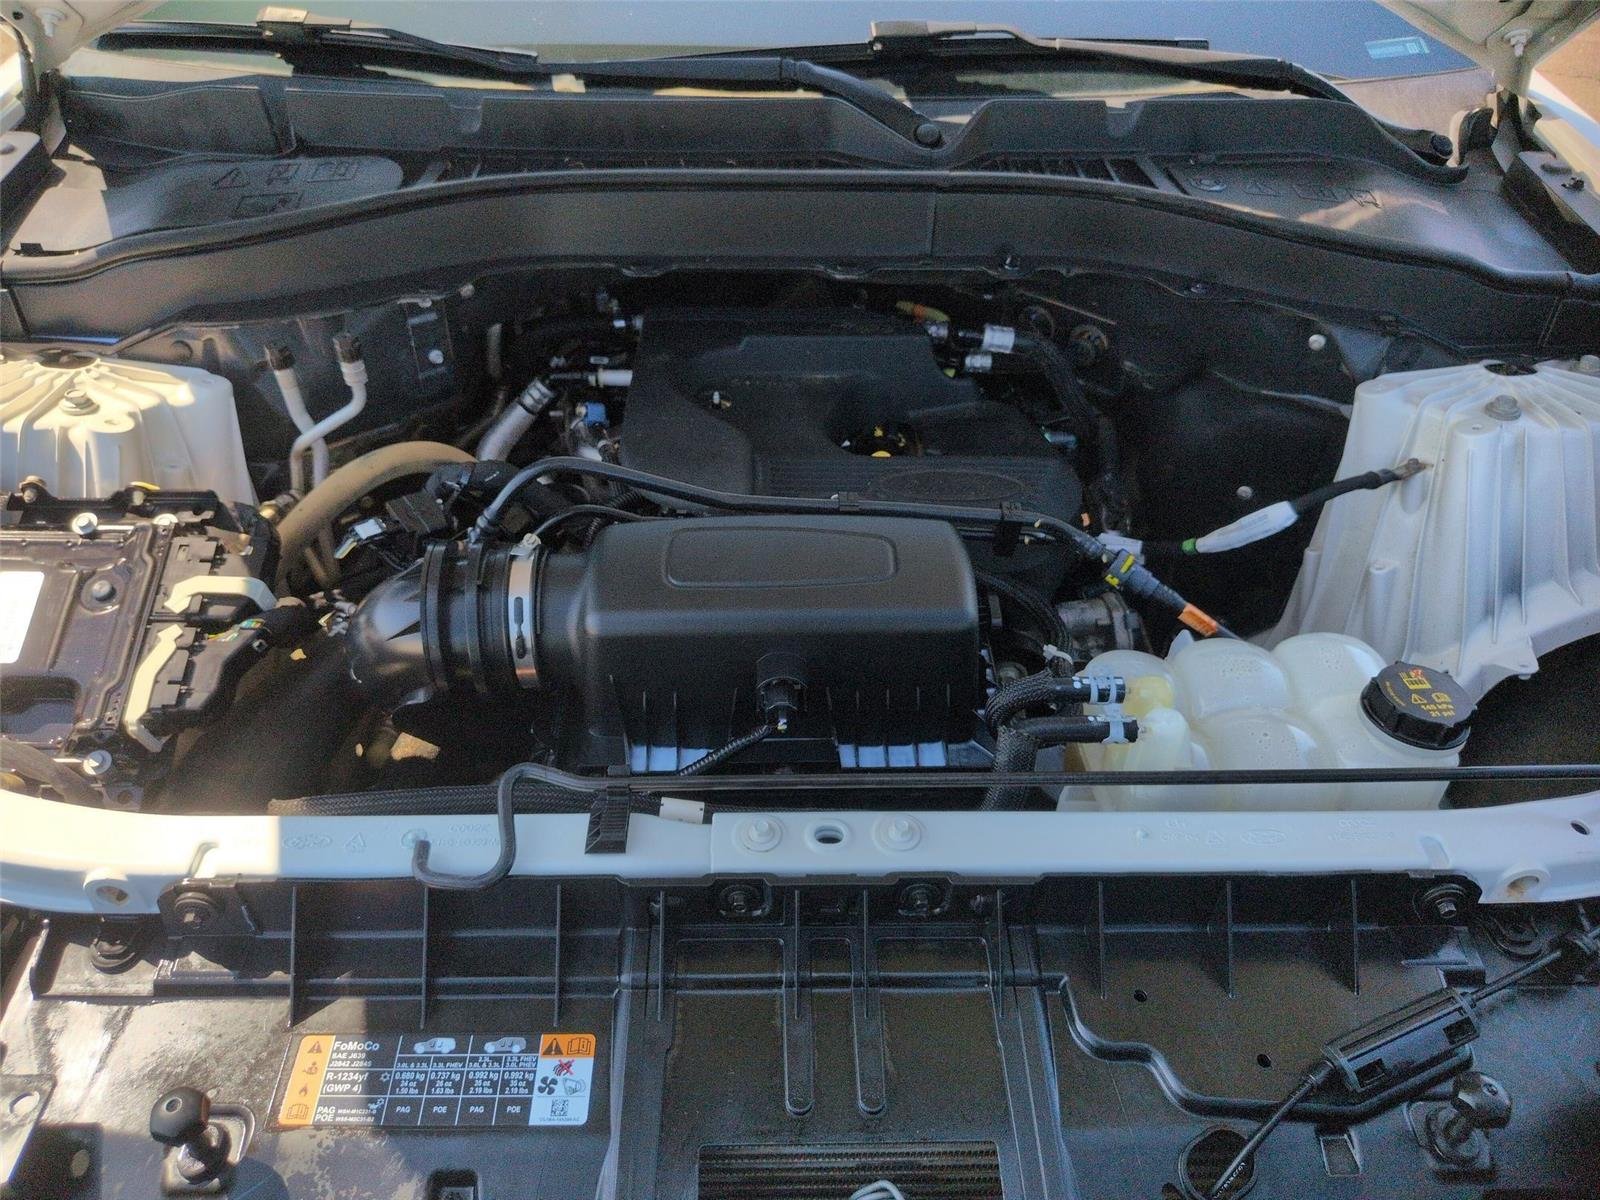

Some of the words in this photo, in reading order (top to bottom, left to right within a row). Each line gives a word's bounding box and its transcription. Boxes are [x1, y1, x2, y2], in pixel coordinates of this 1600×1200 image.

[333, 1041, 380, 1051] FoMoCo
[326, 1072, 369, 1082] R-1234yf
[395, 1072, 415, 1080] 0.680
[416, 1072, 425, 1081] kg
[431, 1072, 450, 1080] 0.737
[451, 1072, 461, 1081] kg
[468, 1071, 488, 1079] 0.992
[489, 1071, 499, 1081] kg
[504, 1071, 524, 1079] 0.992
[525, 1071, 535, 1080] kg
[323, 1084, 351, 1094] (GWP
[352, 1084, 362, 1094] 4)
[317, 1106, 336, 1114] PAG
[469, 1105, 485, 1113] PAG
[506, 1105, 522, 1113] POE
[314, 1114, 335, 1122] POE
